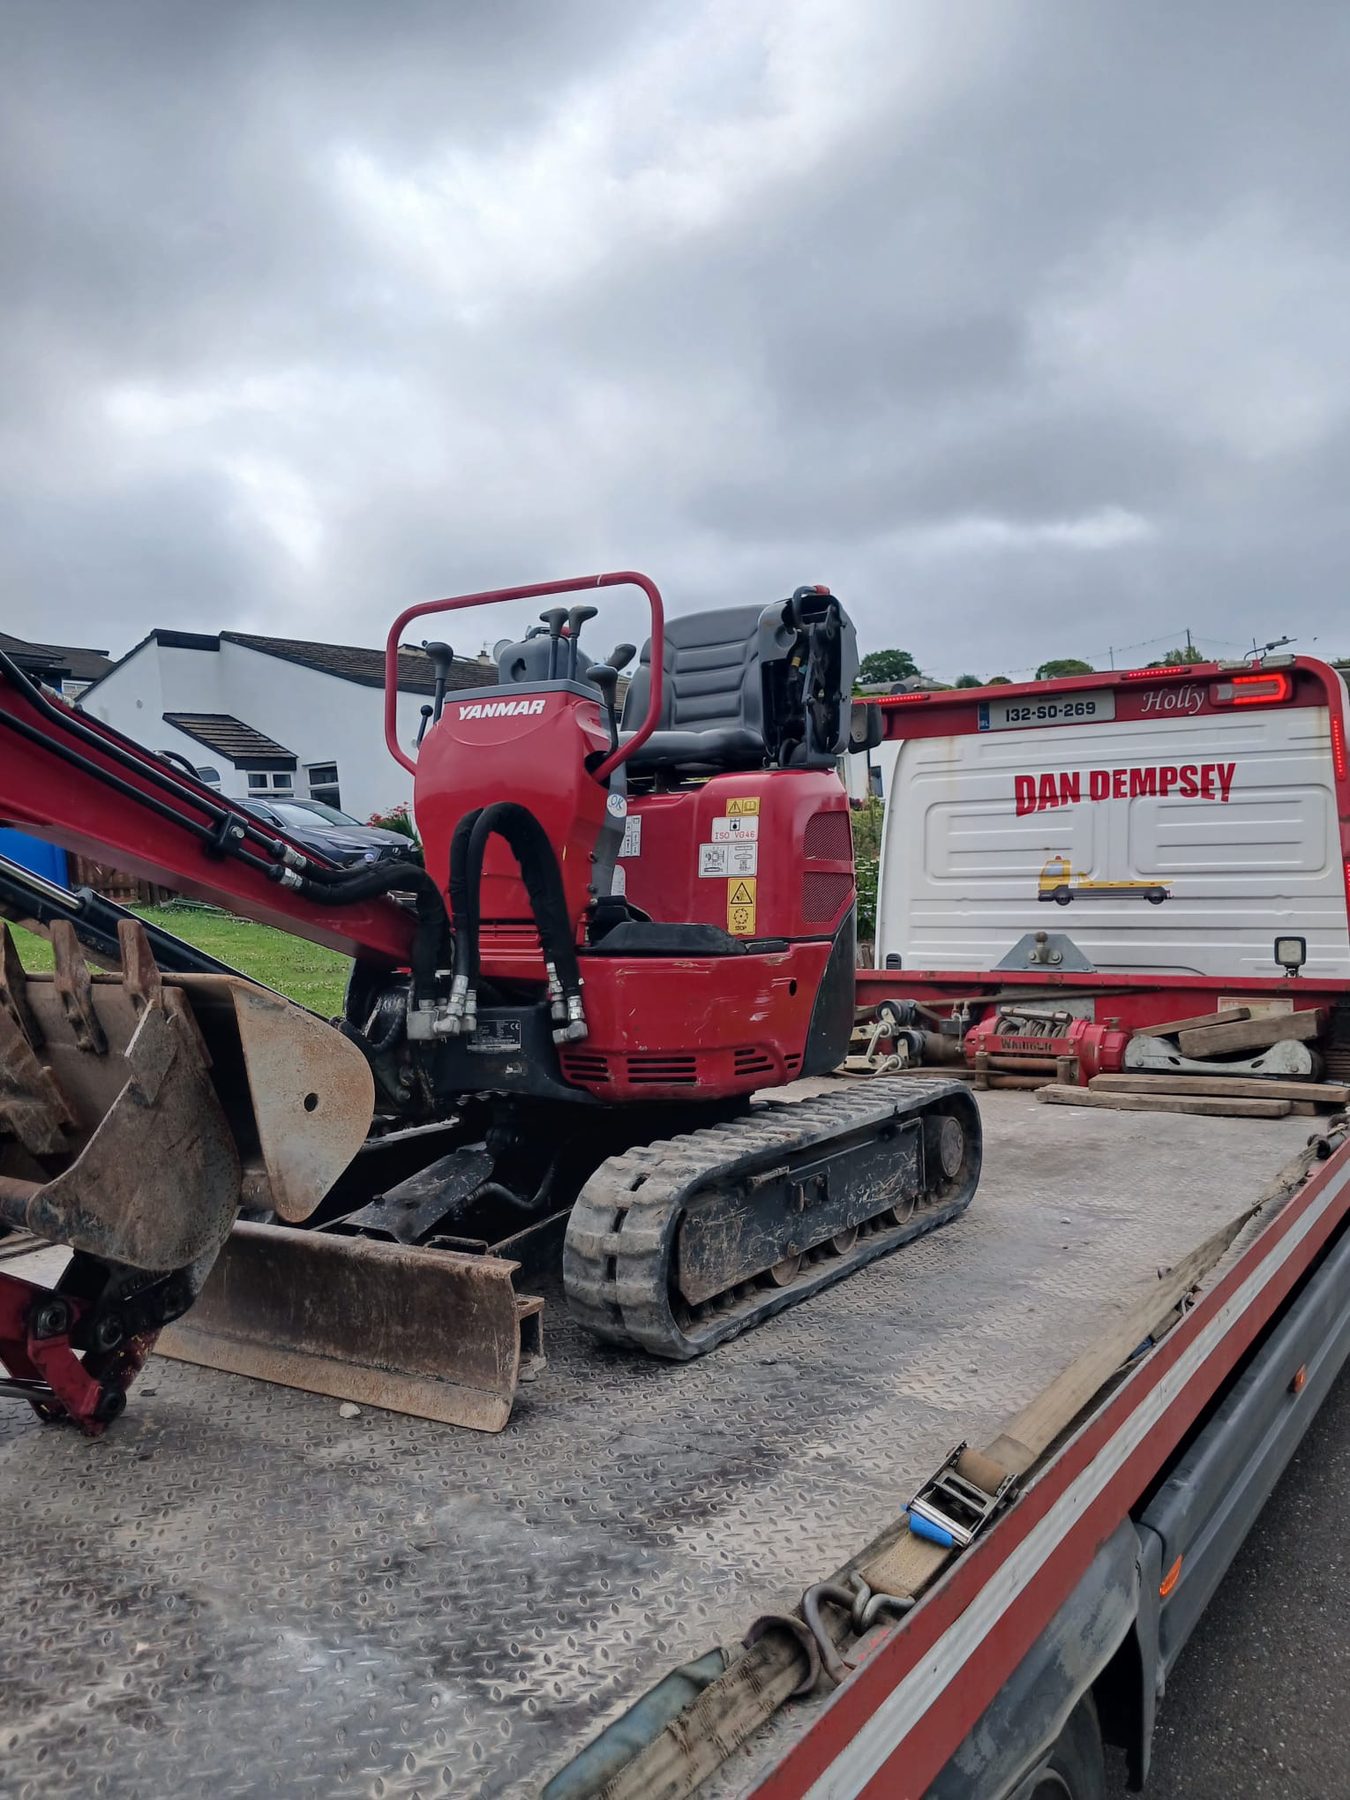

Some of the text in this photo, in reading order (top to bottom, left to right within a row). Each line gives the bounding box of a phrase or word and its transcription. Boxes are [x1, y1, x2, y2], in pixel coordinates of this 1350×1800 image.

[458, 699, 546, 721] YANMAR
[1140, 684, 1205, 714] Holly
[1005, 701, 1096, 722] 132-SO-269
[1014, 762, 1237, 817] DAN DEMPSEY
[714, 830, 755, 840] ISO VG46
